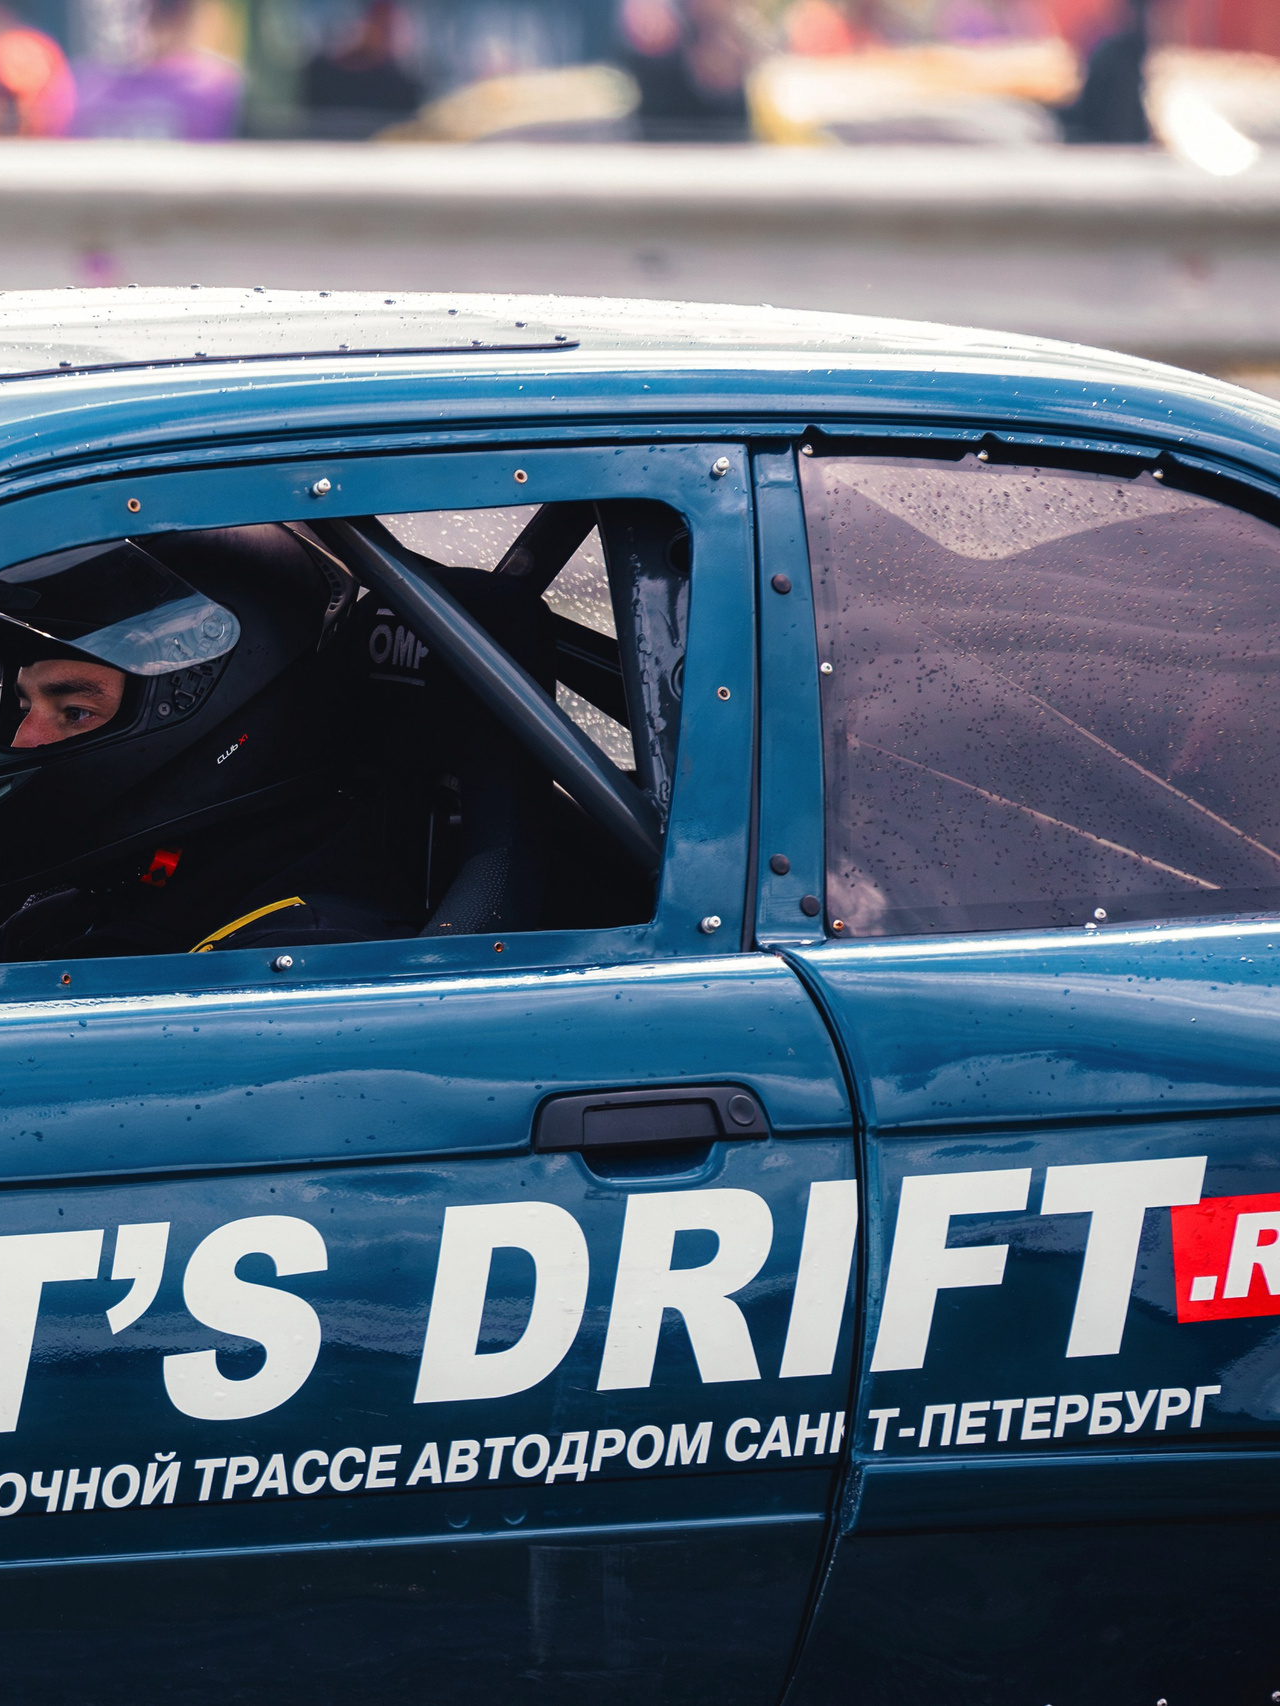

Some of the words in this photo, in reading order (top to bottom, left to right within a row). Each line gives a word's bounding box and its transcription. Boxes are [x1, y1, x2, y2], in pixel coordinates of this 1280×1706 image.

[413, 1155, 1208, 1405] DRIFT
[193, 1443, 403, 1501] ТРАССЕ
[405, 1421, 714, 1487] АВТОДРОМ
